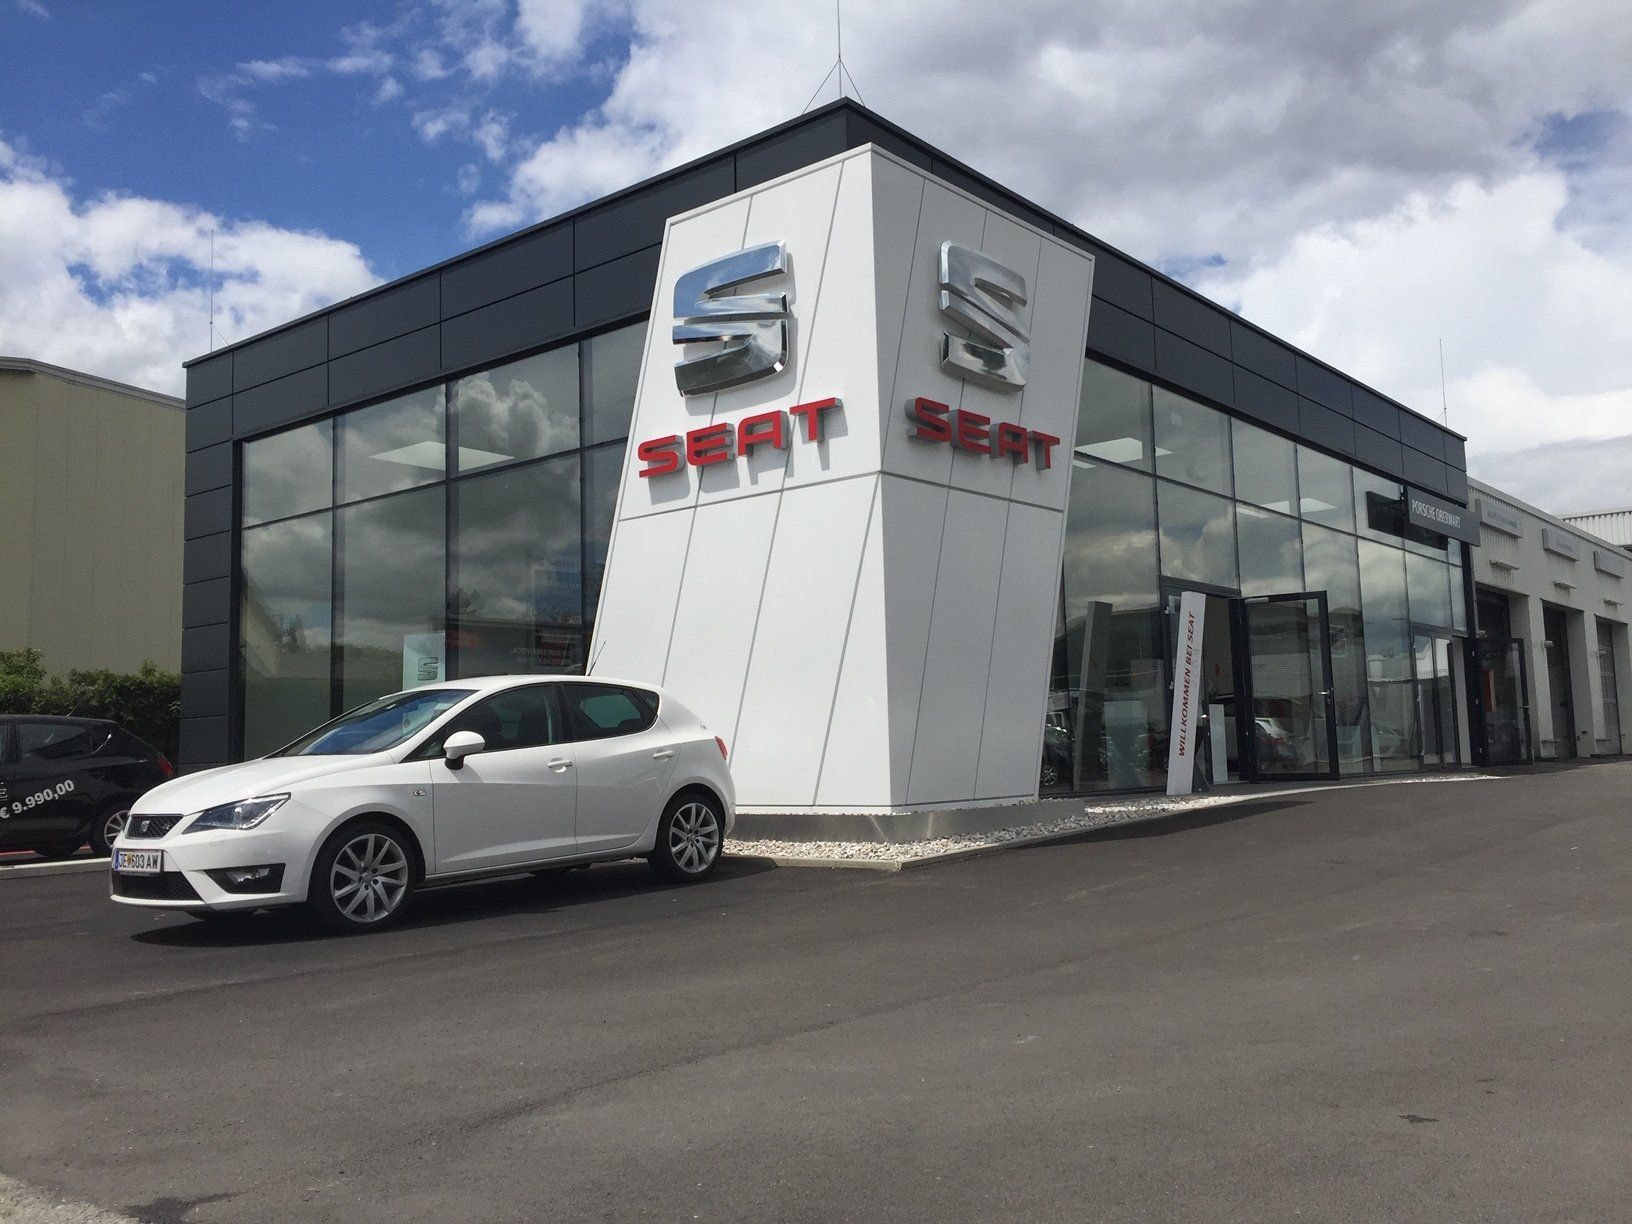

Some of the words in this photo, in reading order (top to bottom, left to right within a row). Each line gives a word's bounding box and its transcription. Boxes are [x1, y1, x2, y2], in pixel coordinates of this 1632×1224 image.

[637, 397, 842, 478] SEAT
[906, 397, 1061, 471] SEAT
[1411, 498, 1436, 521] PORSCHE
[1187, 609, 1195, 644] SEAT
[1185, 644, 1193, 666] BEI
[1178, 667, 1191, 757] WILLKOMMEN
[11, 779, 75, 814] 9.990,00
